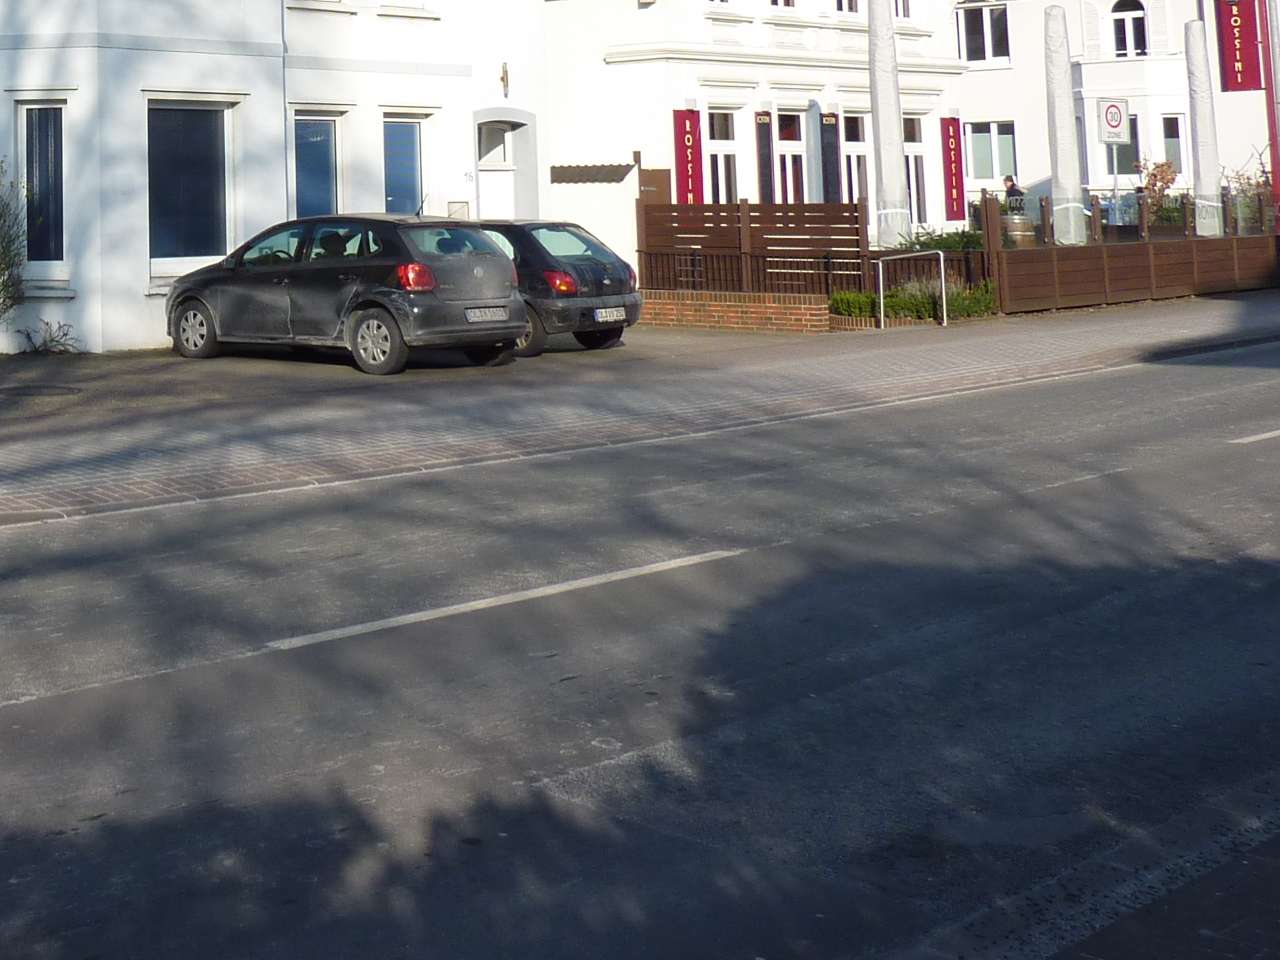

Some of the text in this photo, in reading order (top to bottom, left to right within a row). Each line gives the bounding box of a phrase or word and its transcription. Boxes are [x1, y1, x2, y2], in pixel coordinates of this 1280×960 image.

[1230, 5, 1243, 84] ROSSINI
[1106, 131, 1122, 139] ZONE
[1108, 111, 1119, 123] 30
[463, 171, 474, 184] 16
[684, 119, 694, 205] ROSSIN
[948, 125, 959, 212] ROSSINI
